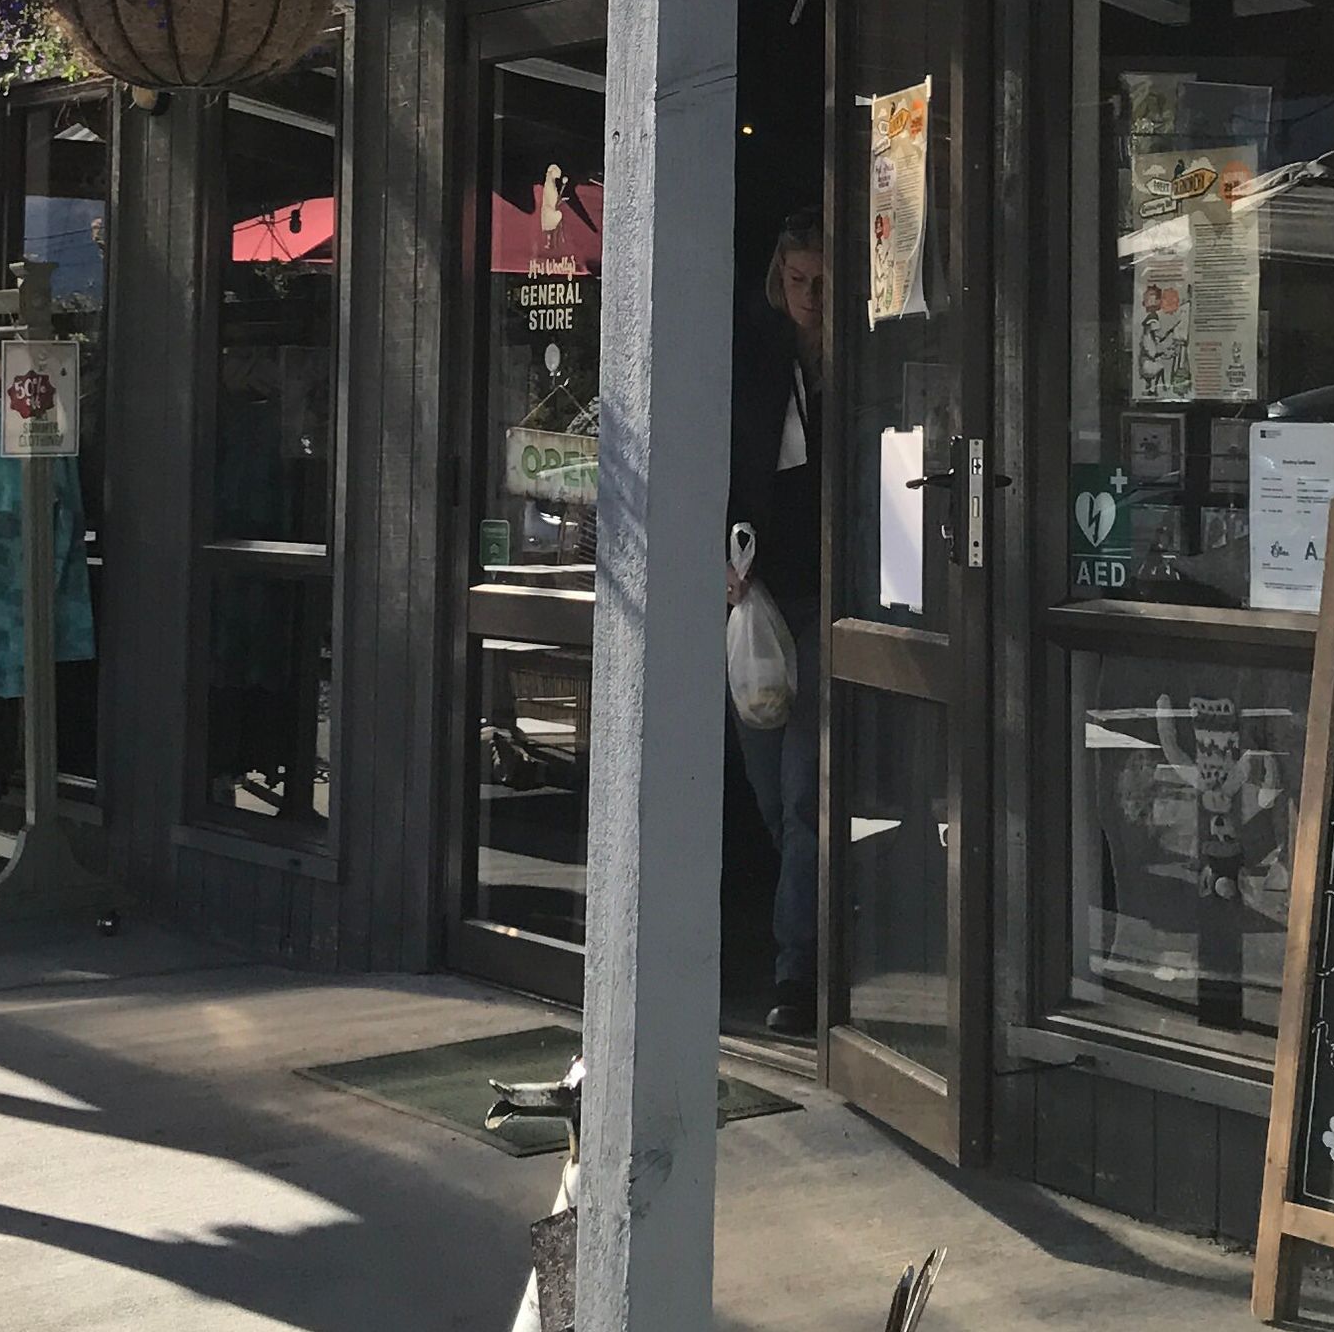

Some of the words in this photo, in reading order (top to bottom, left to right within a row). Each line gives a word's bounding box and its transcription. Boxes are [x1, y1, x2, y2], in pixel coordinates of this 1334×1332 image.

[520, 282, 583, 307] GENERAL
[528, 308, 573, 330] STORE
[14, 377, 46, 399] 50%
[1304, 541, 1318, 560] A
[1076, 561, 1126, 587] AED
